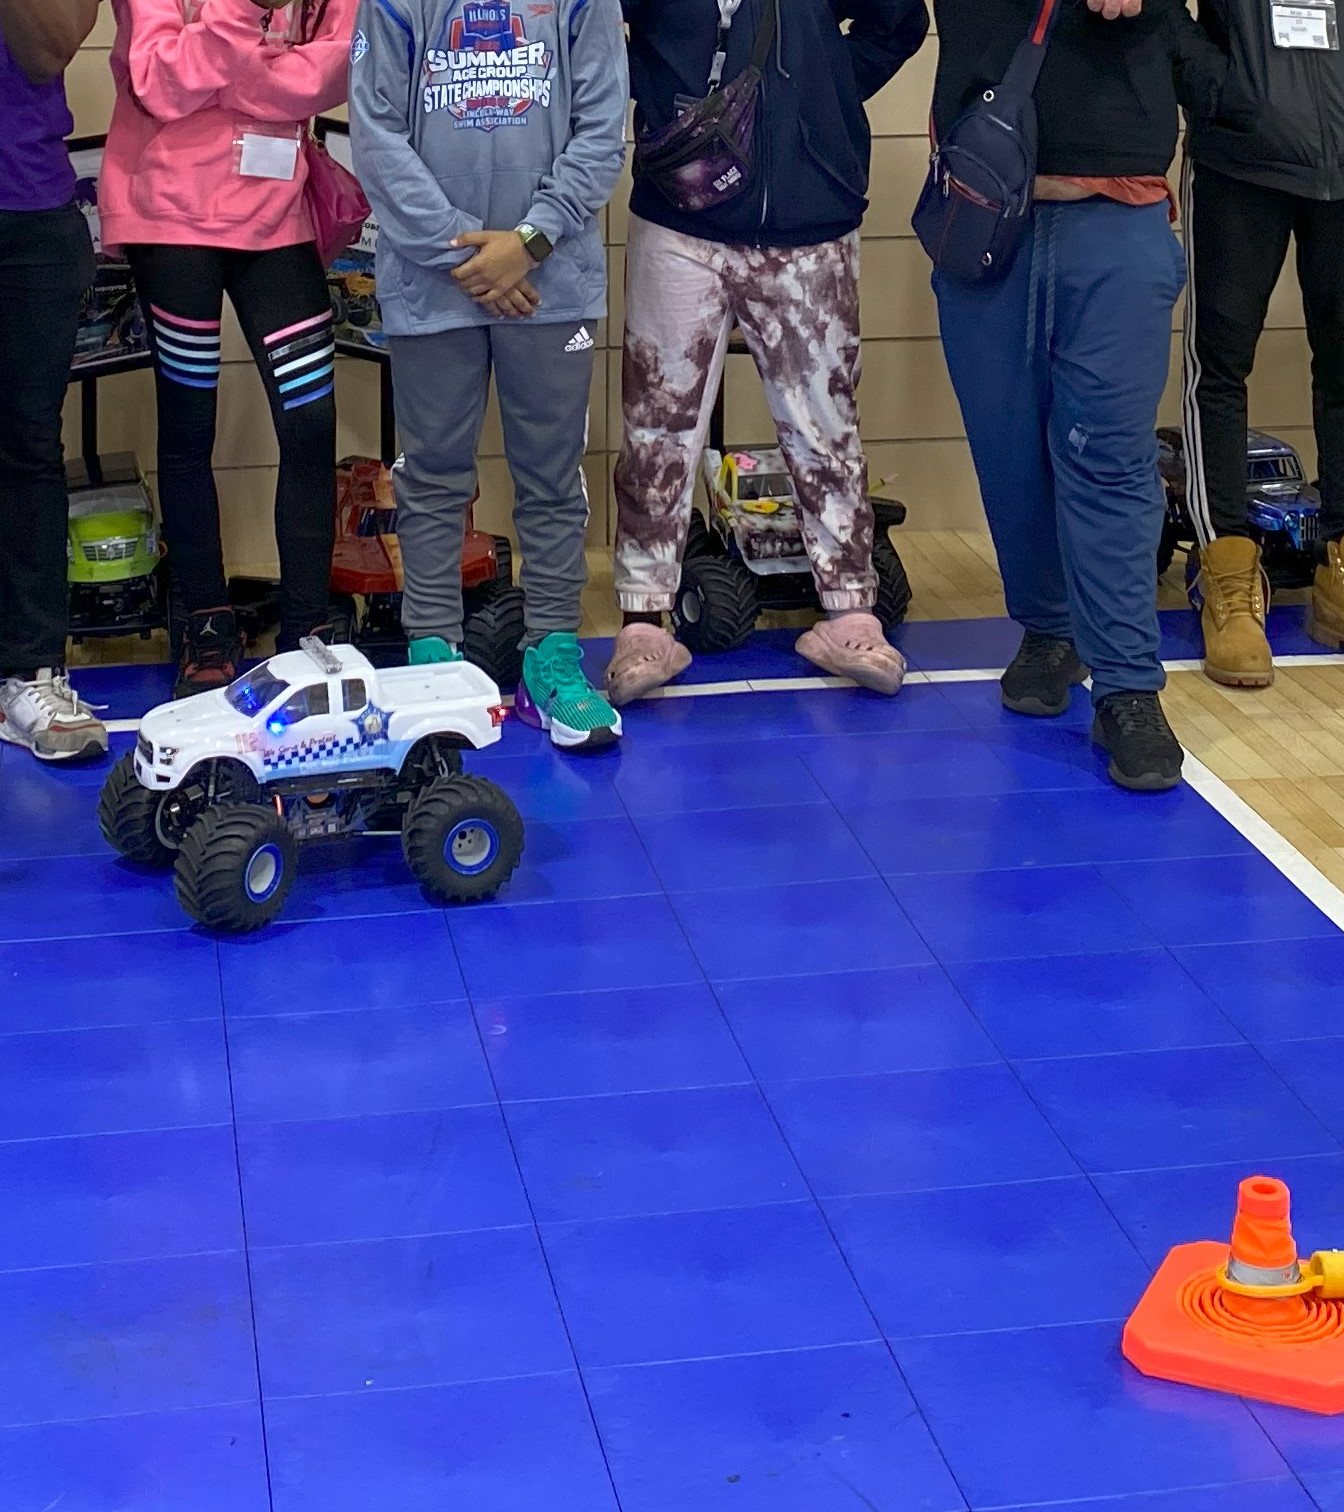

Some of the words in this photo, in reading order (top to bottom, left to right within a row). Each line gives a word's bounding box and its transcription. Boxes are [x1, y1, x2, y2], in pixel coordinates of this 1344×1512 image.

[426, 41, 546, 73] SUMMER
[477, 66, 528, 79] GROUP
[423, 83, 462, 113] STATE
[462, 78, 551, 108] CHAMPIONSHPS
